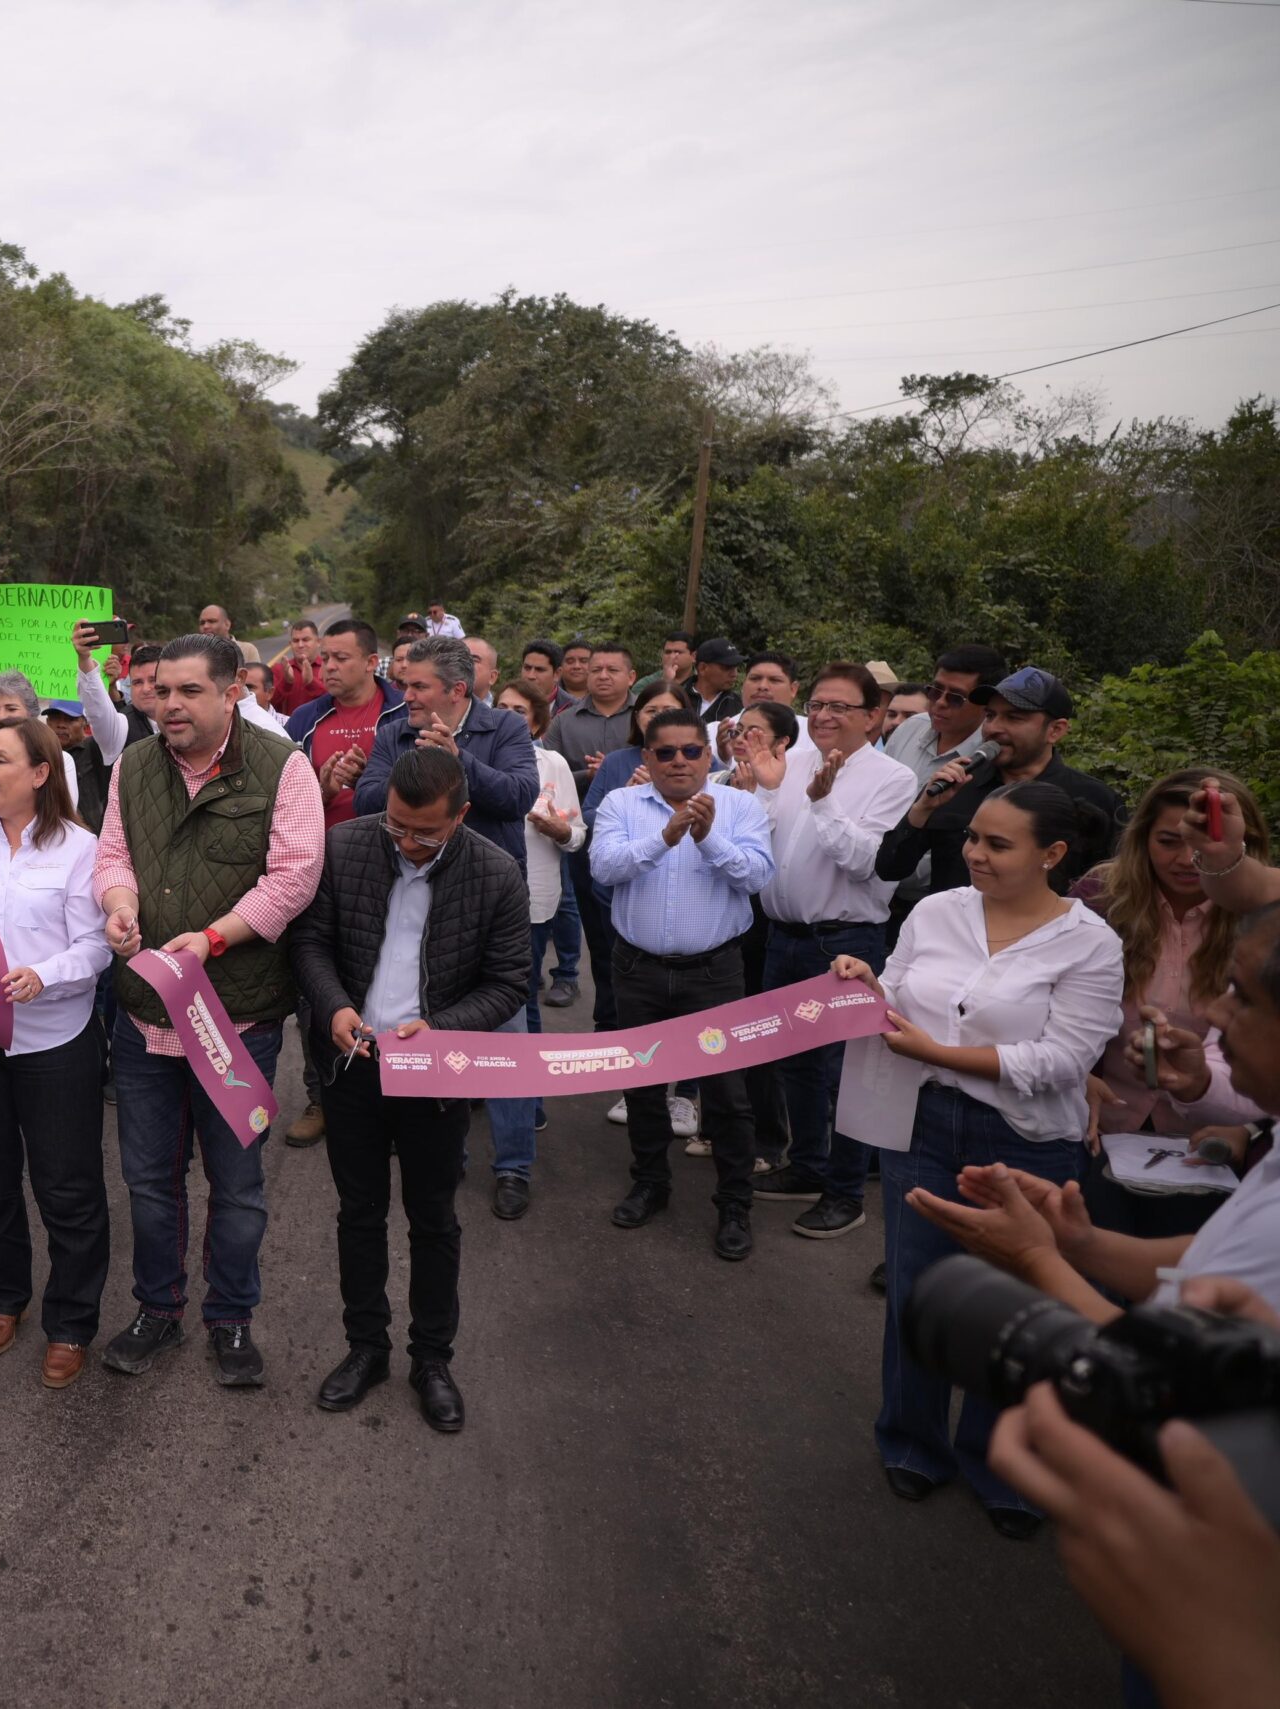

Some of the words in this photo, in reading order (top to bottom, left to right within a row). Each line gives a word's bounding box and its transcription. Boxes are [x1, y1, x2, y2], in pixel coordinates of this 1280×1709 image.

[21, 618, 40, 628] POR
[45, 619, 58, 629] LA
[0, 632, 20, 642] DEL
[28, 633, 73, 645] TERREN
[18, 651, 41, 660] ATTE
[828, 997, 876, 1008] VERACRUZ
[730, 1018, 783, 1038] VERACRUZ
[546, 1048, 622, 1061] COMPROMISO
[384, 1056, 433, 1065] VERACRUZ
[472, 1060, 518, 1068] VERACRUZ
